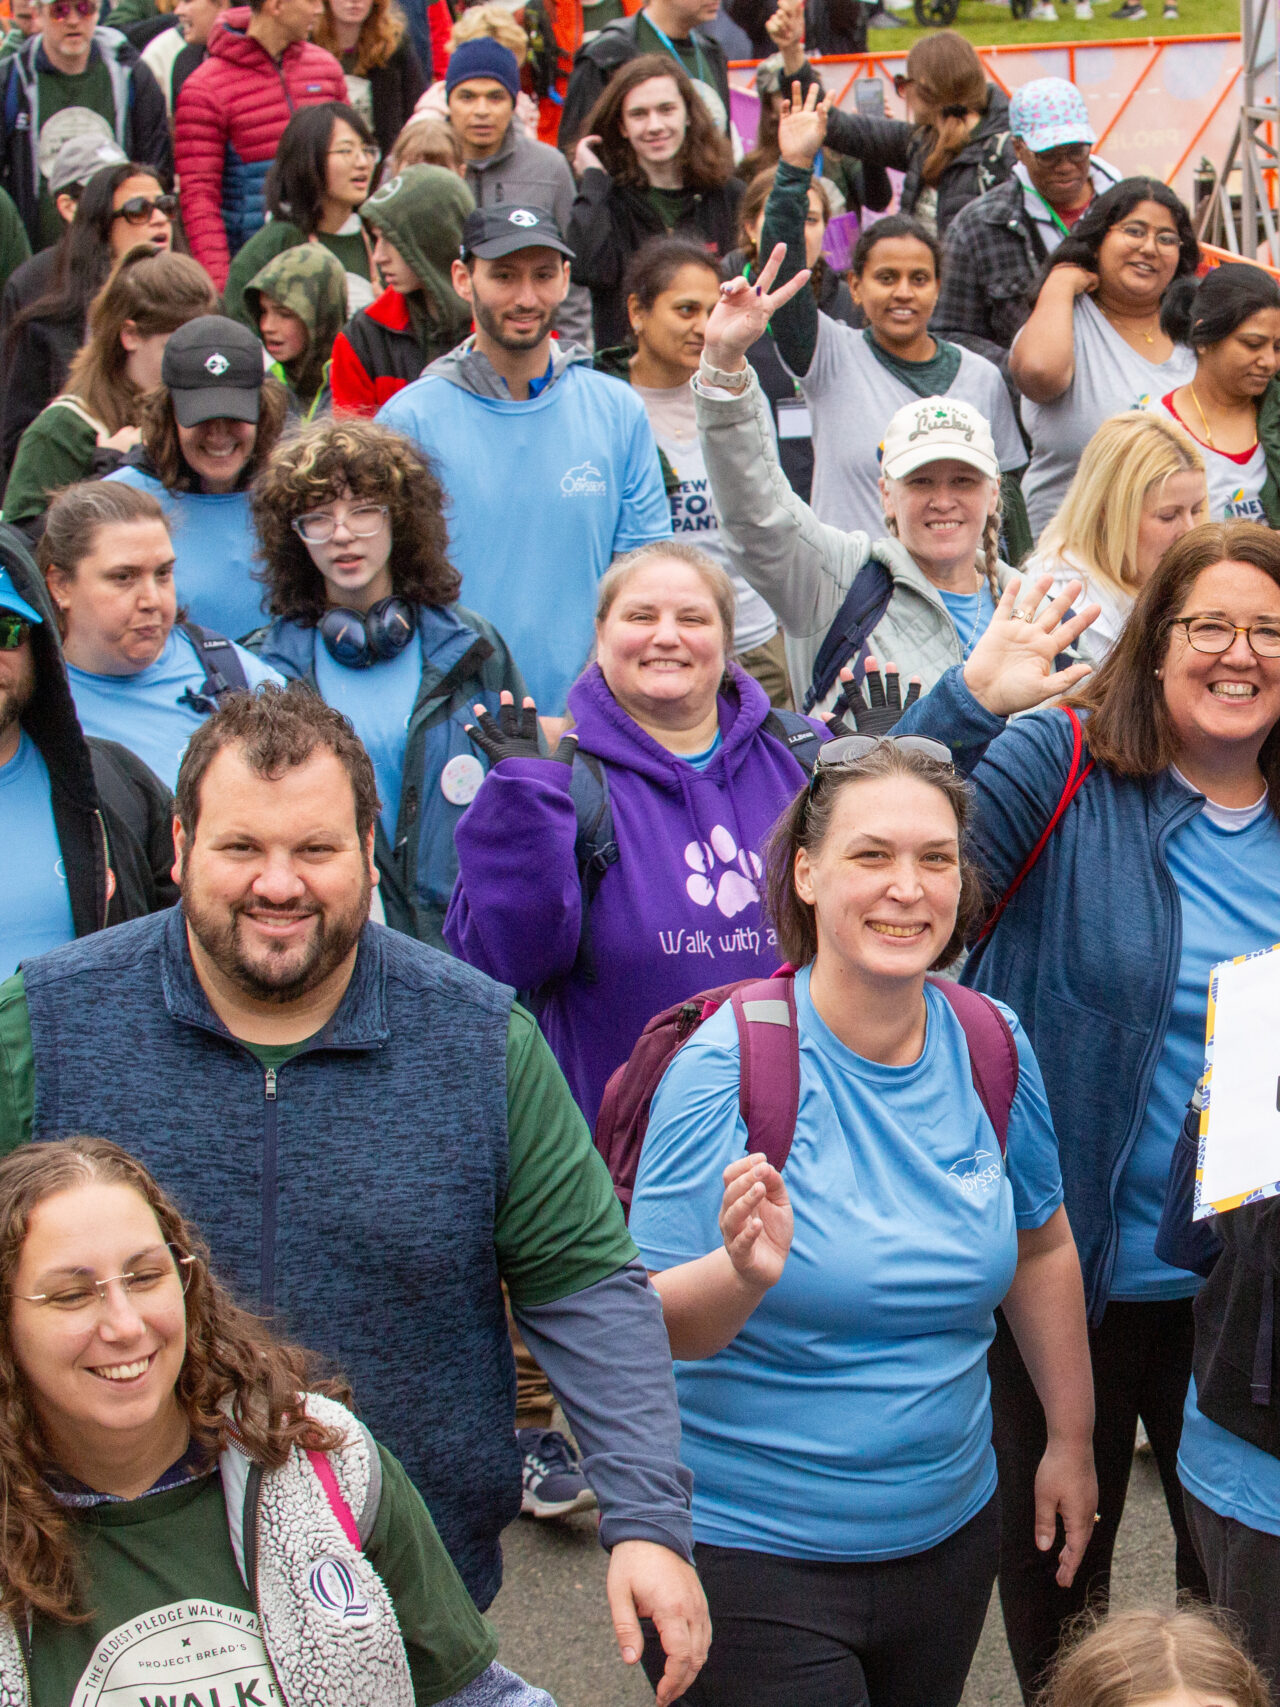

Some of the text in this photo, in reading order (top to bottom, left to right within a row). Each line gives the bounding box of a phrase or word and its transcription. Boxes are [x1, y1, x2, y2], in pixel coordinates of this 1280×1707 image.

[908, 413, 975, 442] Lucky
[658, 928, 715, 958] Walk
[719, 926, 760, 955] with
[86, 1665, 104, 1689] THE
[99, 1629, 134, 1662] OLDEST
[135, 1607, 184, 1634] PLEDGE
[188, 1604, 223, 1618] WALK
[229, 1611, 242, 1624] IN
[138, 1643, 247, 1668] PROJECT BREAD'S
